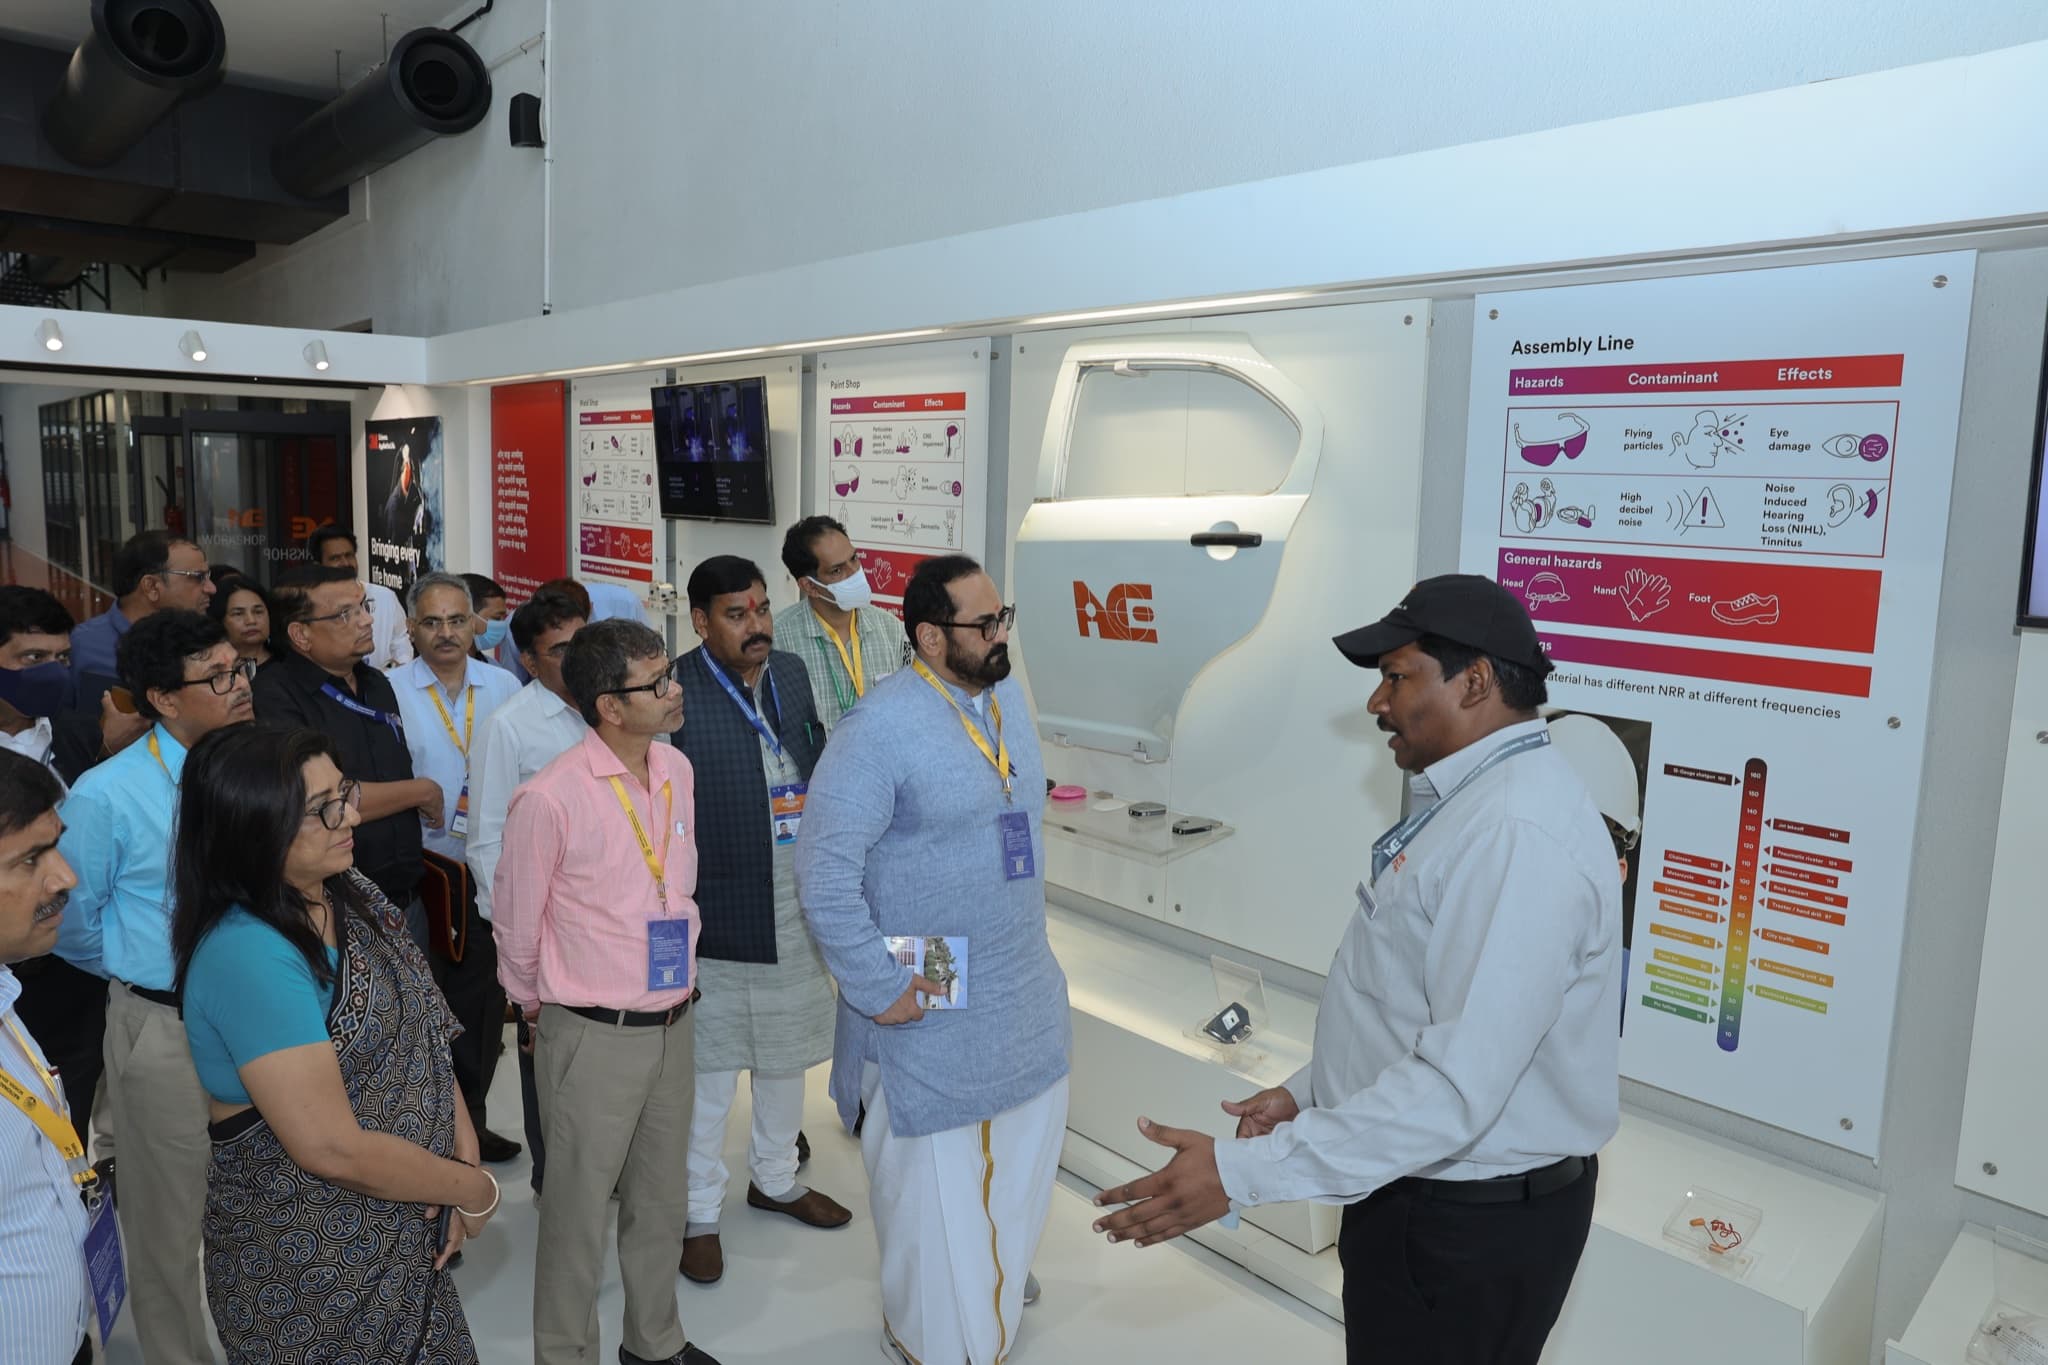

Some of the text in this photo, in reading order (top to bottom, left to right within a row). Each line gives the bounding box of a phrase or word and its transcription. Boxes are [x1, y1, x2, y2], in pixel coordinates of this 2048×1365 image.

[1511, 335, 1634, 355] Assembly Line
[1628, 371, 1718, 385] Contaminant
[1777, 368, 1833, 382] Effects
[830, 380, 860, 389] Paint Shop
[1515, 376, 1564, 389] Hazards
[873, 400, 906, 409] Contaminant
[924, 398, 944, 407] Effects
[1624, 428, 1652, 439] Flying
[1770, 428, 1789, 439] Eye
[1623, 441, 1663, 452] particles
[1768, 442, 1811, 453] damage
[1765, 483, 1795, 493] Noise
[1620, 492, 1642, 503] High
[1764, 497, 1807, 507] Induced
[1619, 504, 1653, 515] decibel
[1618, 517, 1642, 527] noise
[1763, 511, 1804, 522] Hearing
[1762, 523, 1826, 536] Loss (NIHL),
[1761, 536, 1802, 547] Tinnitus
[371, 537, 421, 568] Bringing every
[1504, 552, 1602, 570] General hazards
[372, 565, 403, 590] life home
[1502, 578, 1524, 589] Head
[1593, 585, 1617, 596] Hand
[1689, 593, 1711, 603] Foot
[1584, 675, 1603, 688] has
[1606, 679, 1654, 694] different
[1659, 684, 1685, 699] NRR
[1688, 690, 1700, 700] at
[1704, 690, 1757, 708] different
[1761, 697, 1841, 719] frequencies
[1748, 790, 1759, 798] 150
[1741, 859, 1751, 867] 110
